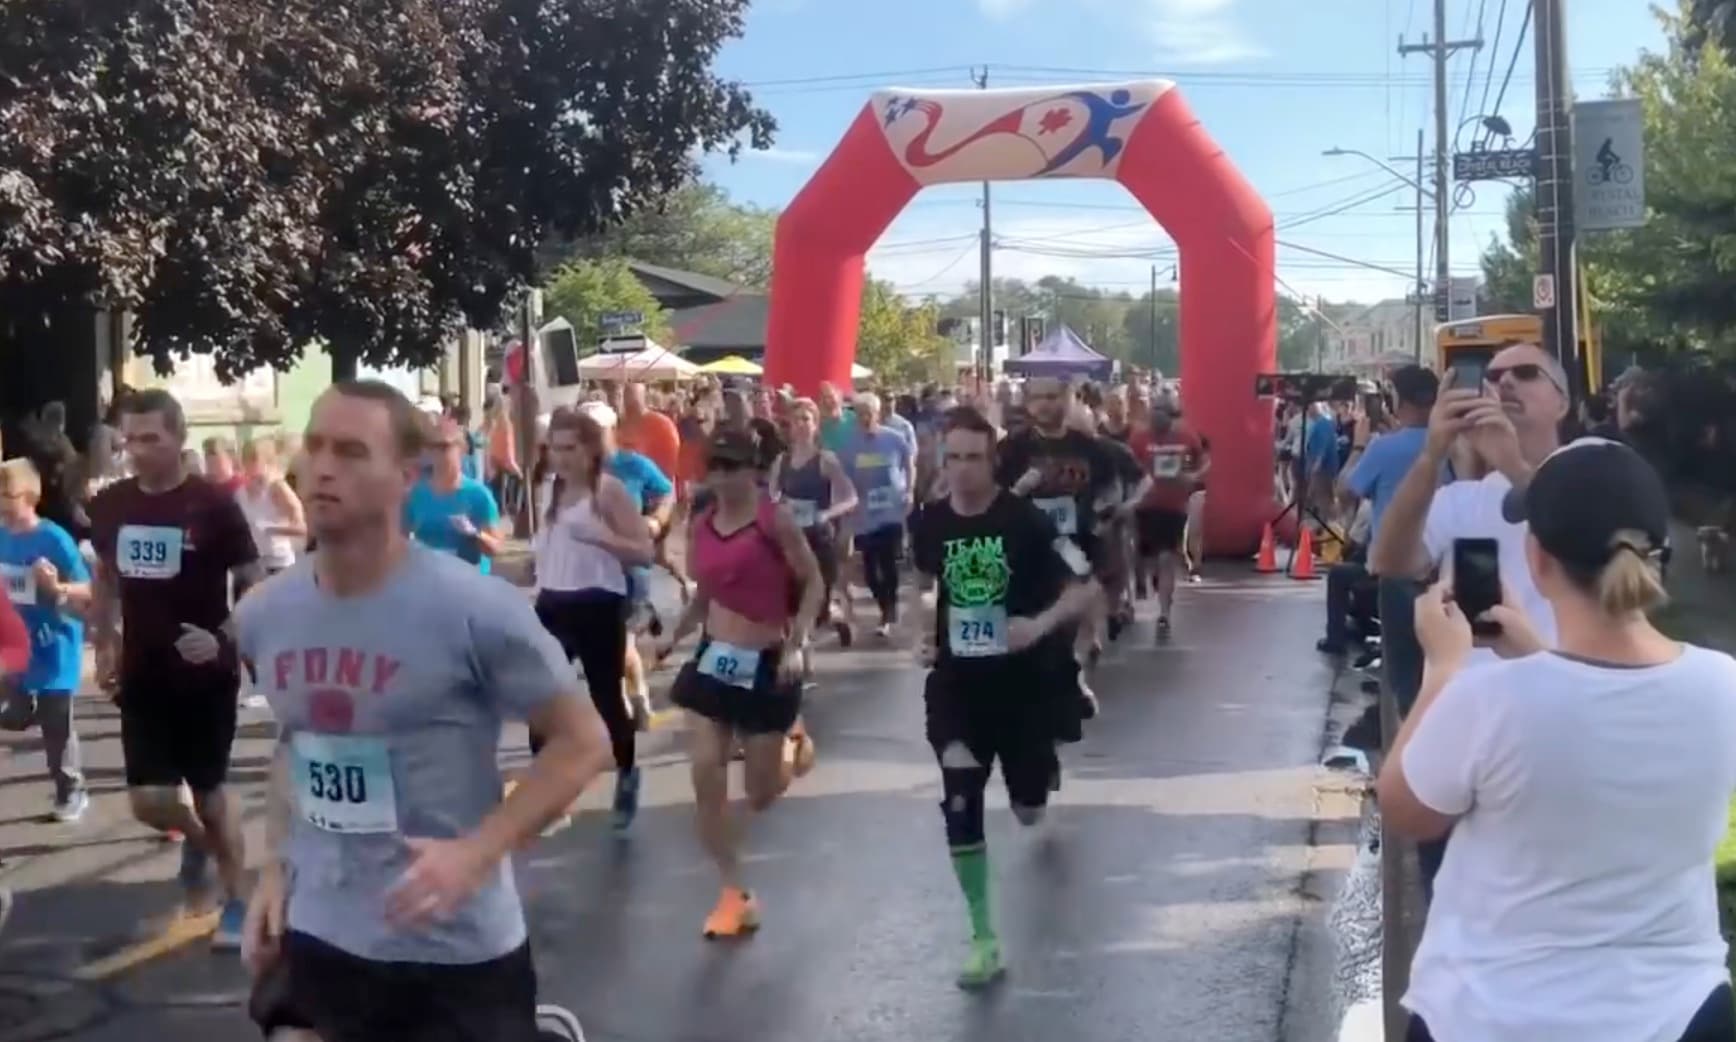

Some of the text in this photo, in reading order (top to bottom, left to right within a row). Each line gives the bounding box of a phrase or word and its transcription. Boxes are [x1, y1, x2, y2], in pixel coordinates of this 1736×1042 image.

[128, 539, 168, 562] 339
[943, 535, 1004, 557] TEAM
[959, 620, 995, 641] 274
[274, 647, 401, 693] FDNY
[308, 760, 367, 804] 530
